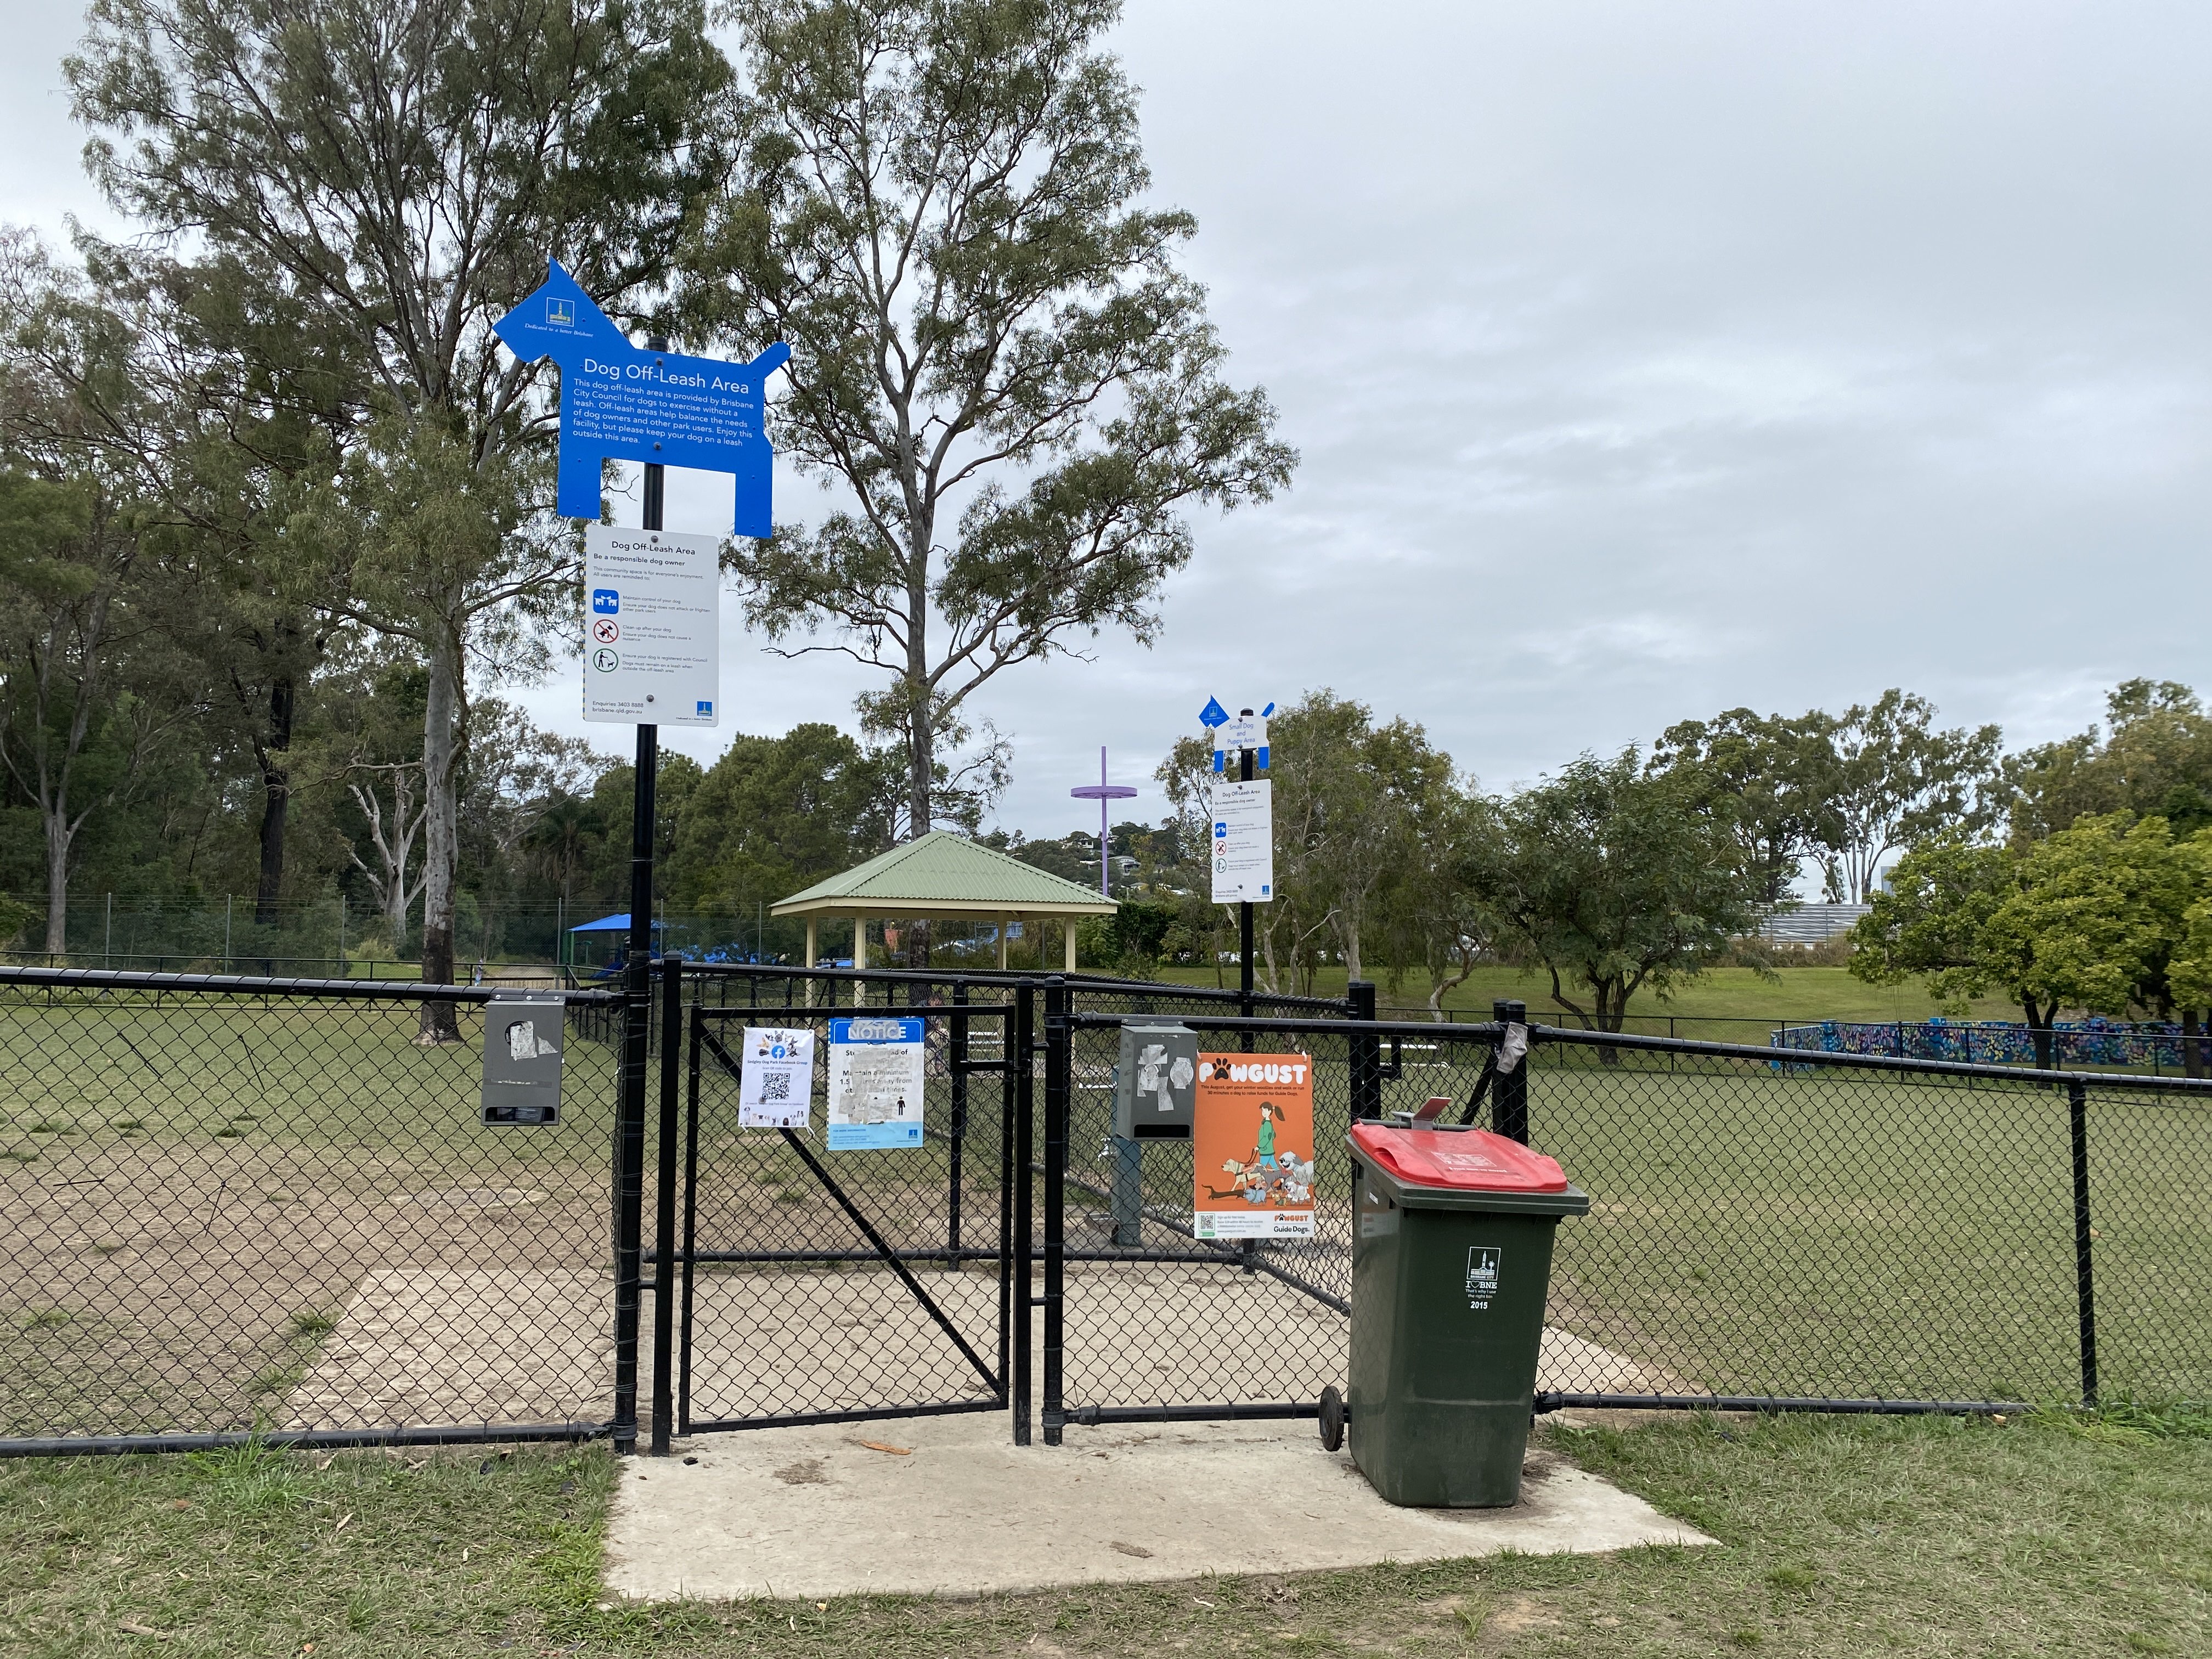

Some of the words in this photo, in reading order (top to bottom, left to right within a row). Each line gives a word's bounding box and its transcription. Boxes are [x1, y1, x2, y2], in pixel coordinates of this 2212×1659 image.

[585, 358, 620, 380] Dog
[627, 365, 706, 388] Off-Leash
[711, 376, 749, 394] Area
[574, 379, 590, 387] This
[592, 381, 608, 391] dog
[611, 384, 644, 394] off-leash
[674, 394, 708, 403] provided
[710, 397, 719, 407] by
[721, 398, 754, 409] Brisbane
[574, 388, 590, 398] City
[592, 391, 622, 401] Council
[624, 394, 635, 403] for
[637, 397, 657, 407] dogs
[670, 403, 701, 411] exercise
[703, 407, 731, 416] without
[574, 398, 596, 408] leash.
[599, 402, 635, 413] Off-leash
[660, 409, 676, 420] help
[679, 412, 708, 422] balance
[725, 420, 748, 428] needs
[584, 410, 600, 420] dog
[602, 414, 631, 422] owners
[650, 419, 671, 427] other
[717, 427, 737, 438] Enjoy
[573, 418, 600, 430] facility,
[603, 422, 616, 431] but
[618, 425, 644, 434] please
[646, 427, 665, 438] keep
[687, 433, 703, 443] dog
[724, 438, 743, 447] leash
[573, 431, 602, 439] outside
[605, 433, 619, 441] this
[612, 541, 630, 551] Dog
[633, 543, 673, 553] Off-Leash
[676, 547, 695, 555] Area
[848, 1026, 906, 1039] NOTICE
[1470, 1301, 1488, 1309] 2015
